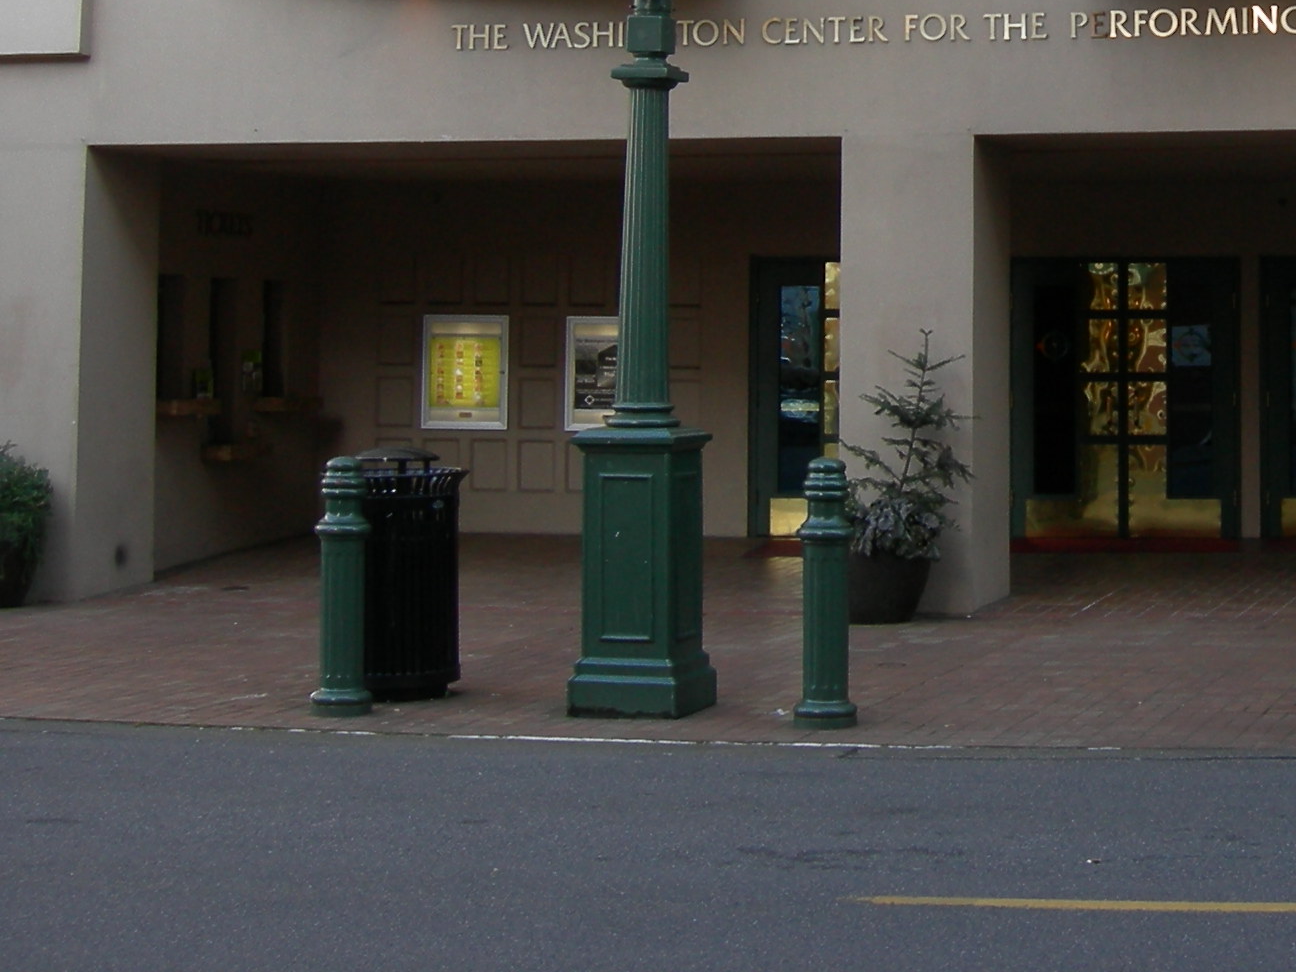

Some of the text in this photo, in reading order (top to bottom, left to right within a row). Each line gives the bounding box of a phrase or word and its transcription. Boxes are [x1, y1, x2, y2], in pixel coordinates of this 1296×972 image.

[452, 23, 508, 52] THE
[523, 17, 745, 50] WASHITON
[761, 14, 889, 45] CENTER
[904, 13, 970, 43] FOR
[983, 11, 1048, 41] THE
